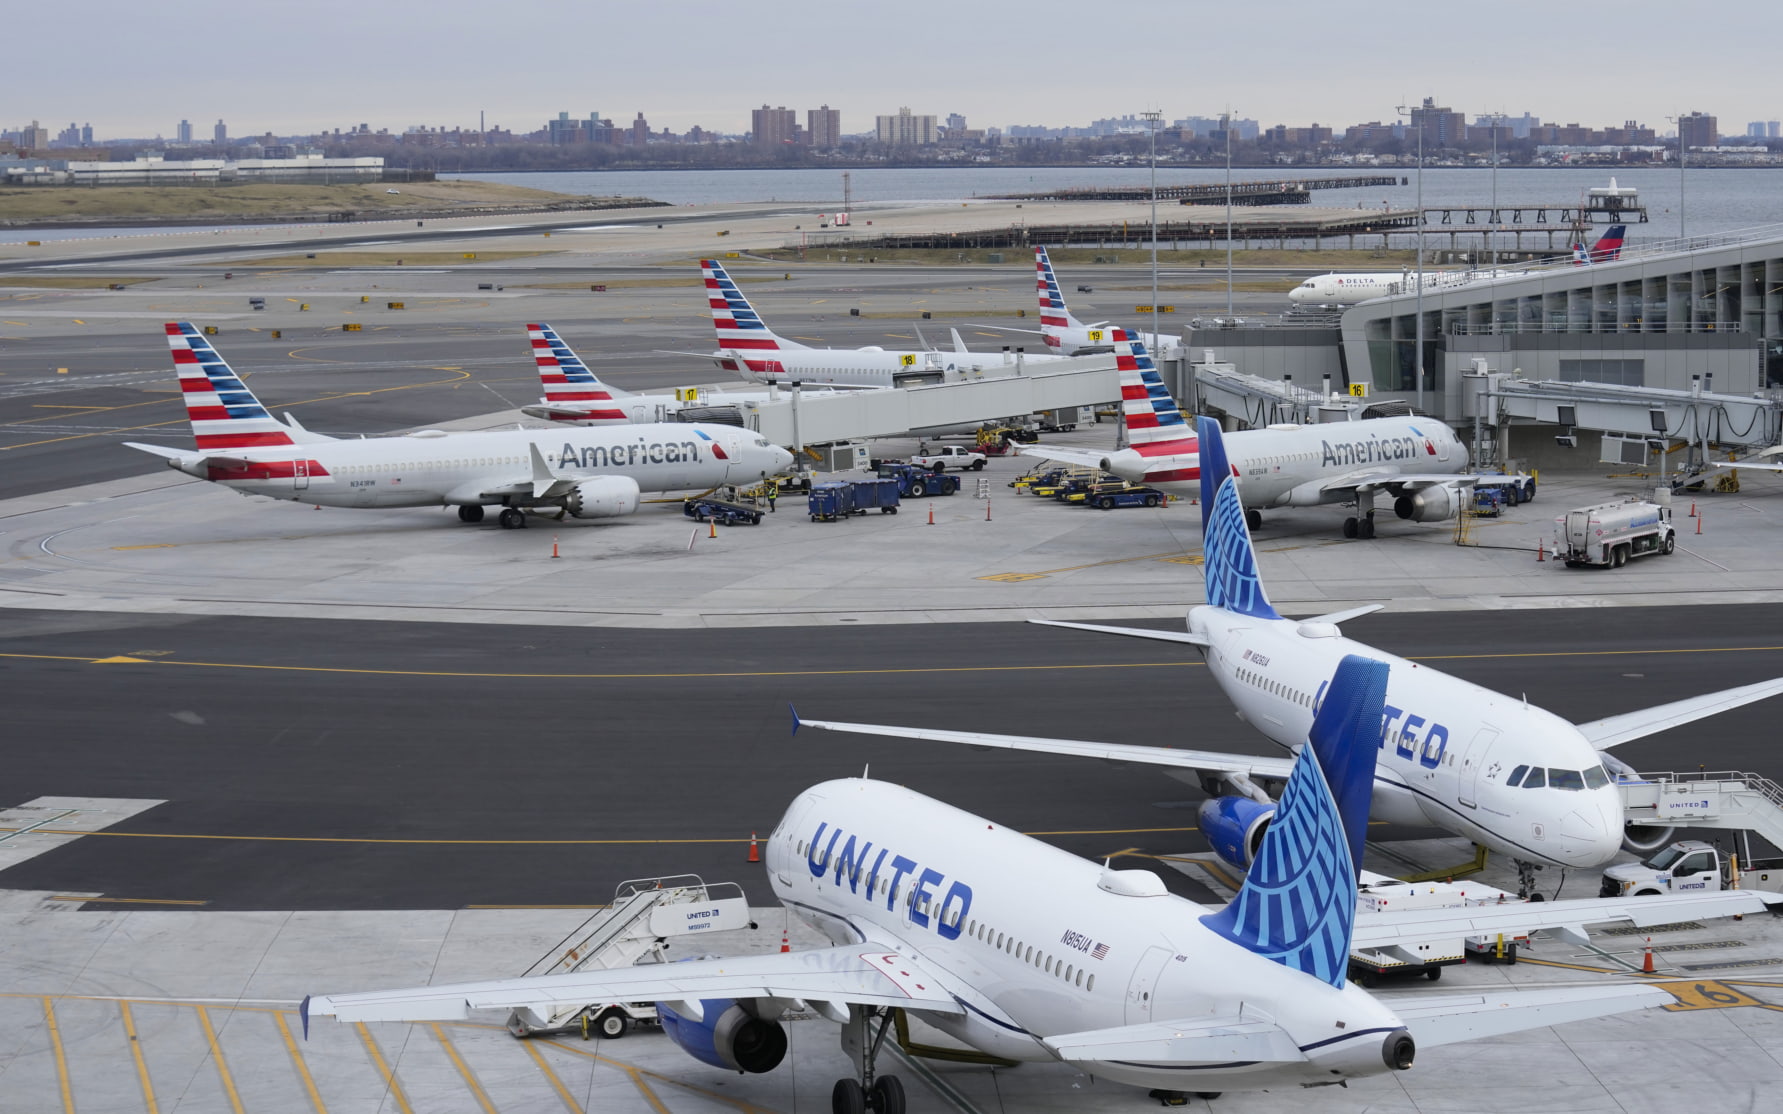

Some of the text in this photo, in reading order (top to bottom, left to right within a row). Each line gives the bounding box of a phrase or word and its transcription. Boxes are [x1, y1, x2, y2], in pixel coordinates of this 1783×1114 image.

[1091, 331, 1100, 341] 19
[904, 355, 913, 365] 18
[687, 389, 695, 400] 17
[1353, 384, 1362, 397] 16
[559, 437, 698, 469] American
[1322, 433, 1416, 468] American
[808, 822, 973, 941] UNITED
[687, 911, 710, 919] UNITED
[1060, 929, 1093, 954] N815UA
